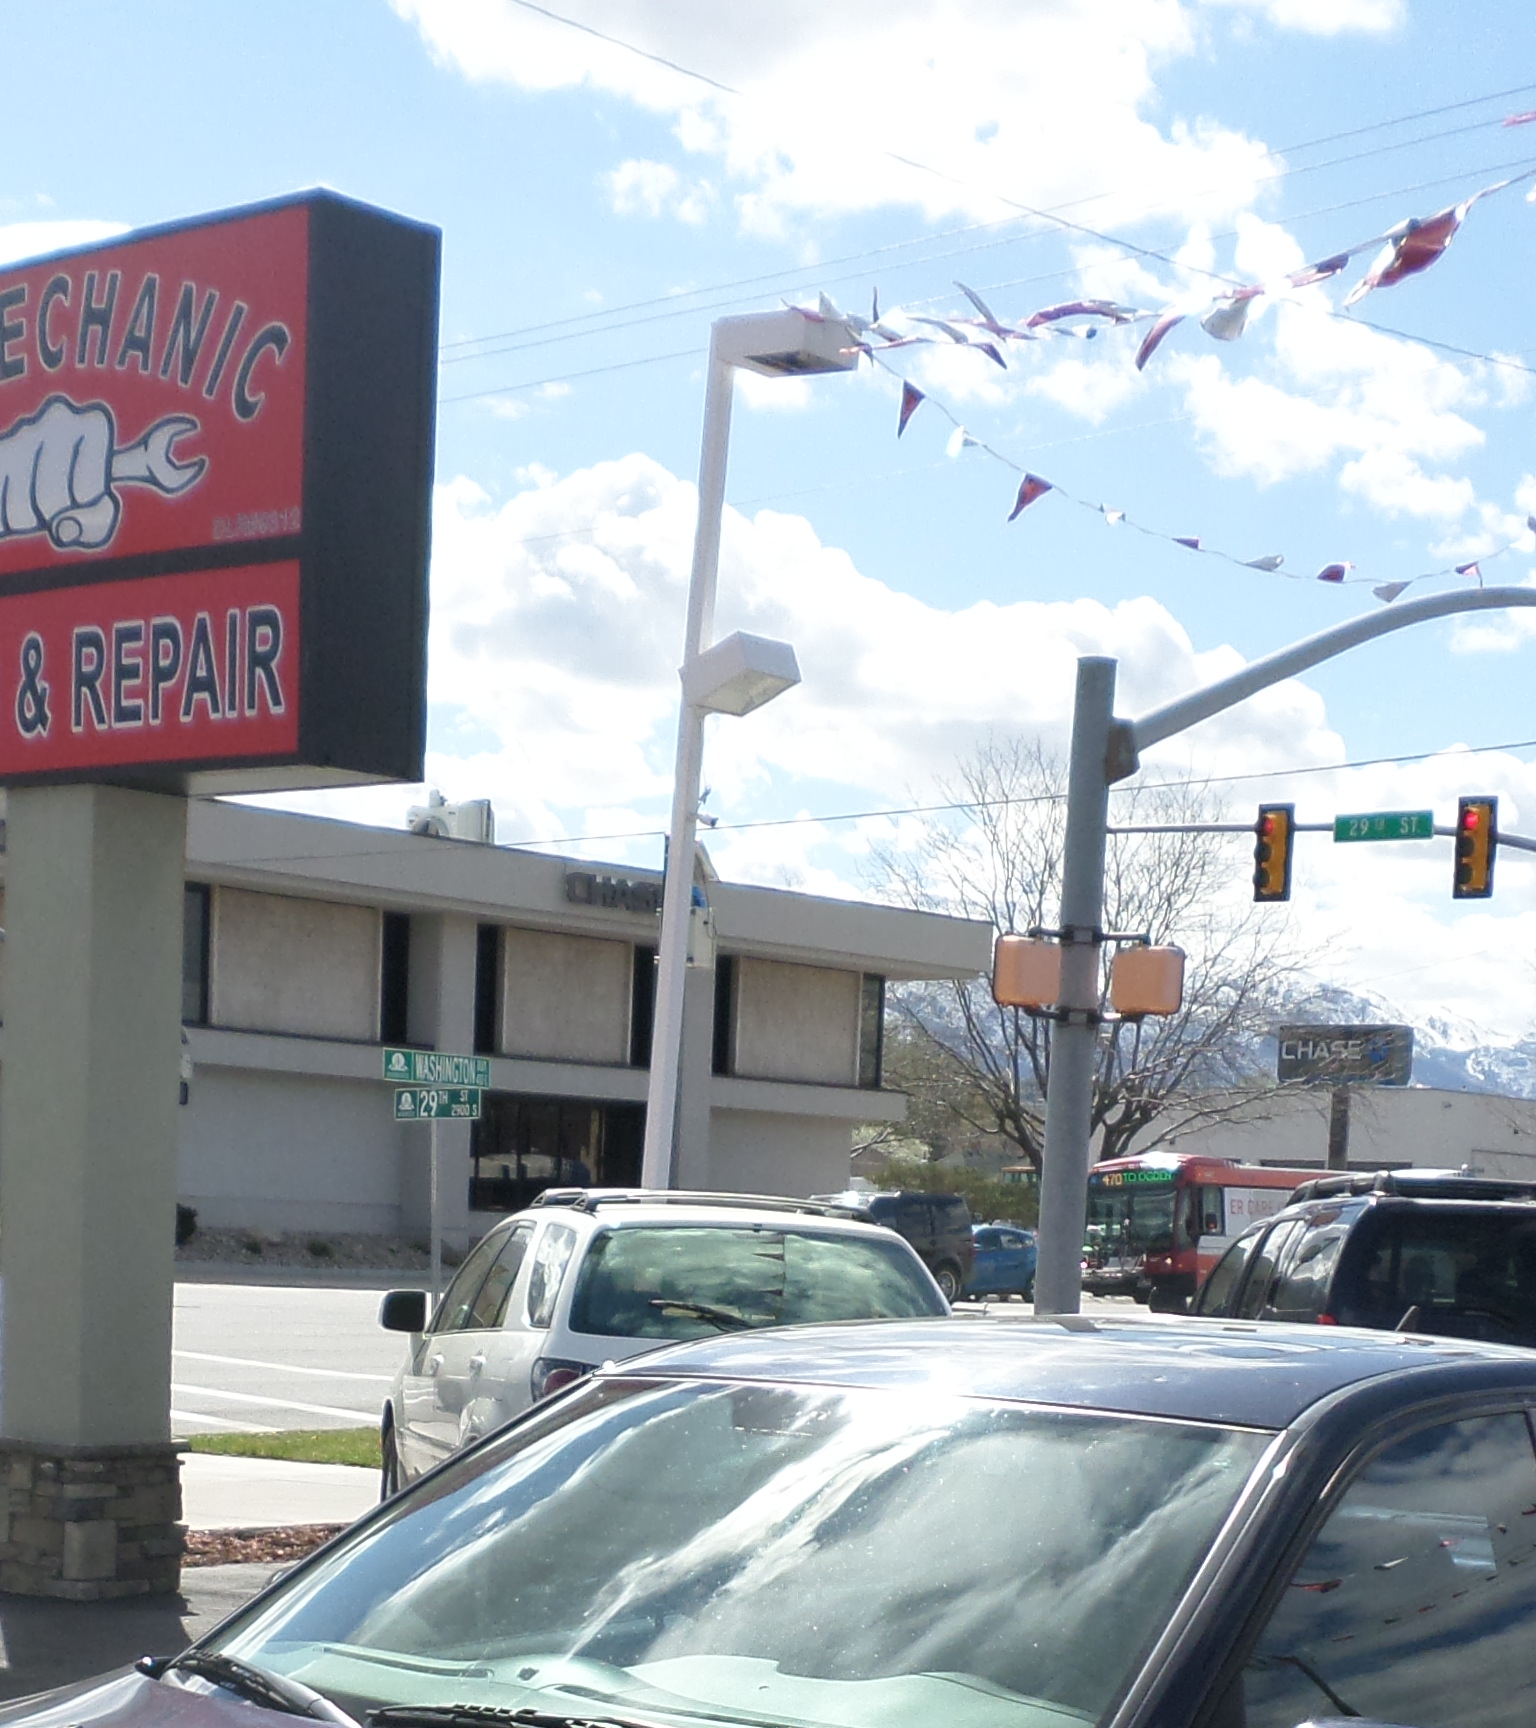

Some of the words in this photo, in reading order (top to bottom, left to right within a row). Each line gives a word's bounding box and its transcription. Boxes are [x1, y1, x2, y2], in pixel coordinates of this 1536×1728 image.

[14, 630, 52, 739] &
[70, 604, 285, 733] REPAIR
[1281, 1040, 1363, 1060] CHASE
[415, 1052, 476, 1086] WASHINGTON
[459, 1090, 469, 1103] ST
[1102, 1173, 1123, 1187] 470
